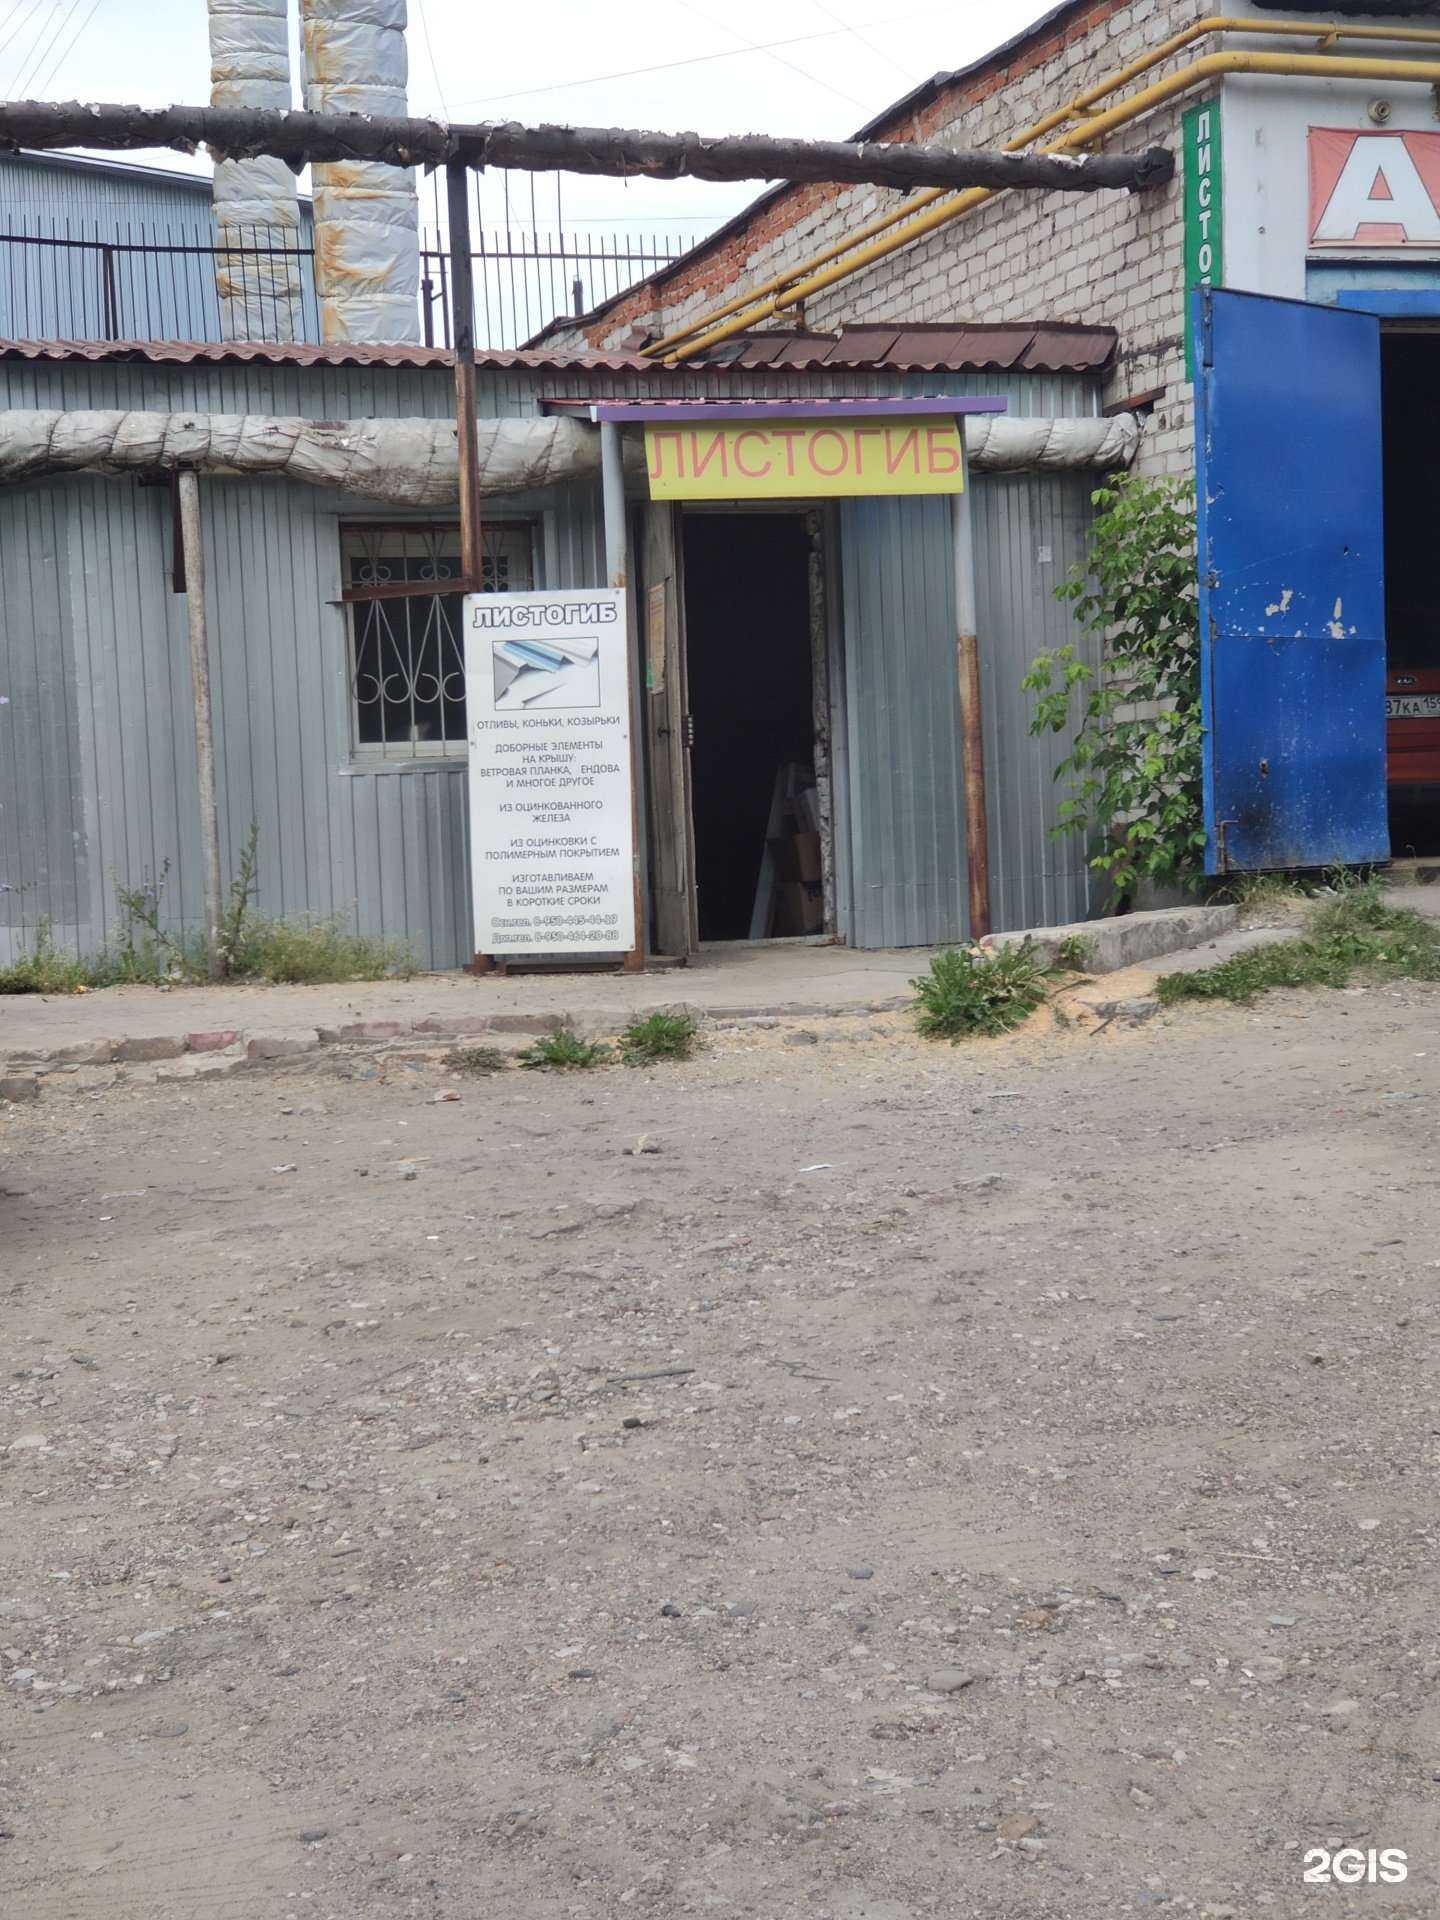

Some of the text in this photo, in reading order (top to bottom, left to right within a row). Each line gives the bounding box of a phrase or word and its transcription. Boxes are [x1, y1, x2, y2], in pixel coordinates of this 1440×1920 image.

[1196, 110, 1213, 285] ЛИСТО
[650, 427, 961, 480] ЛИСТОГИБ
[473, 602, 617, 629] ЛИСТОГИБ
[477, 716, 620, 730] ОТЛИВЫ, КОНЬКИ, КОЗЫРЬКИ
[495, 740, 603, 754] ДОБОРНЫЕ ЭЛЕМЕНТЫ
[522, 754, 536, 764] НА
[481, 764, 620, 777] ВЕТРОВАЯ ПЛАНКА, ЕНДОВА
[506, 777, 595, 788] И МНОГОЕ ДРУГОЕ
[499, 800, 603, 812] ИЗ ОЦИНКОВАННОГО
[532, 813, 571, 823] ЖЕЛЕЗА
[510, 836, 597, 848] ИЗ ОЦИНКОВКИ С
[485, 848, 620, 860] ПОЛИМЕРНЫМ ПОКРЫТИЕМ
[512, 872, 594, 883] ИЗГОТАВЛИВАЕМ
[498, 884, 608, 895] ПО ВАШИМ РАЗМЕРАМ
[506, 896, 601, 907] В КОРОТКИЕ СРОКИ
